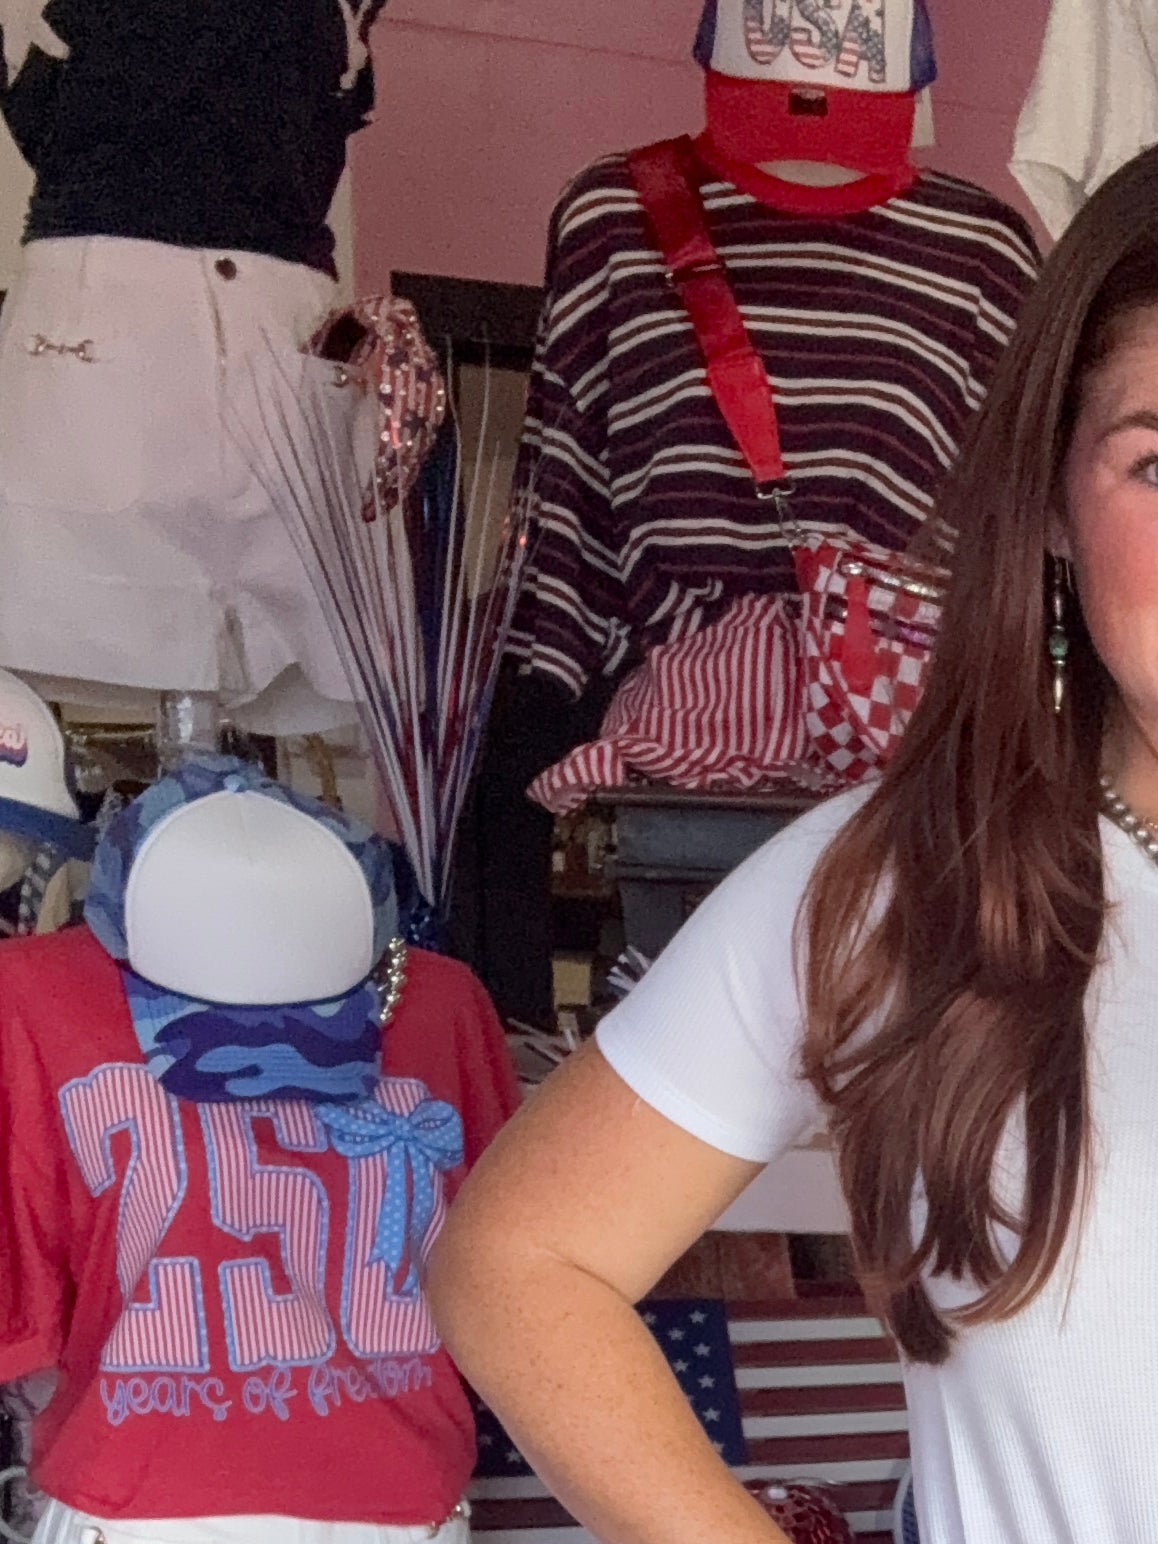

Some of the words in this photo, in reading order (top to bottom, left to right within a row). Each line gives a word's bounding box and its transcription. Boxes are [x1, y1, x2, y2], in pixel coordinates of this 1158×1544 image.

[742, 0, 887, 84] USA
[58, 1062, 449, 1373] 250
[99, 1376, 233, 1427] years
[242, 1365, 299, 1422] of
